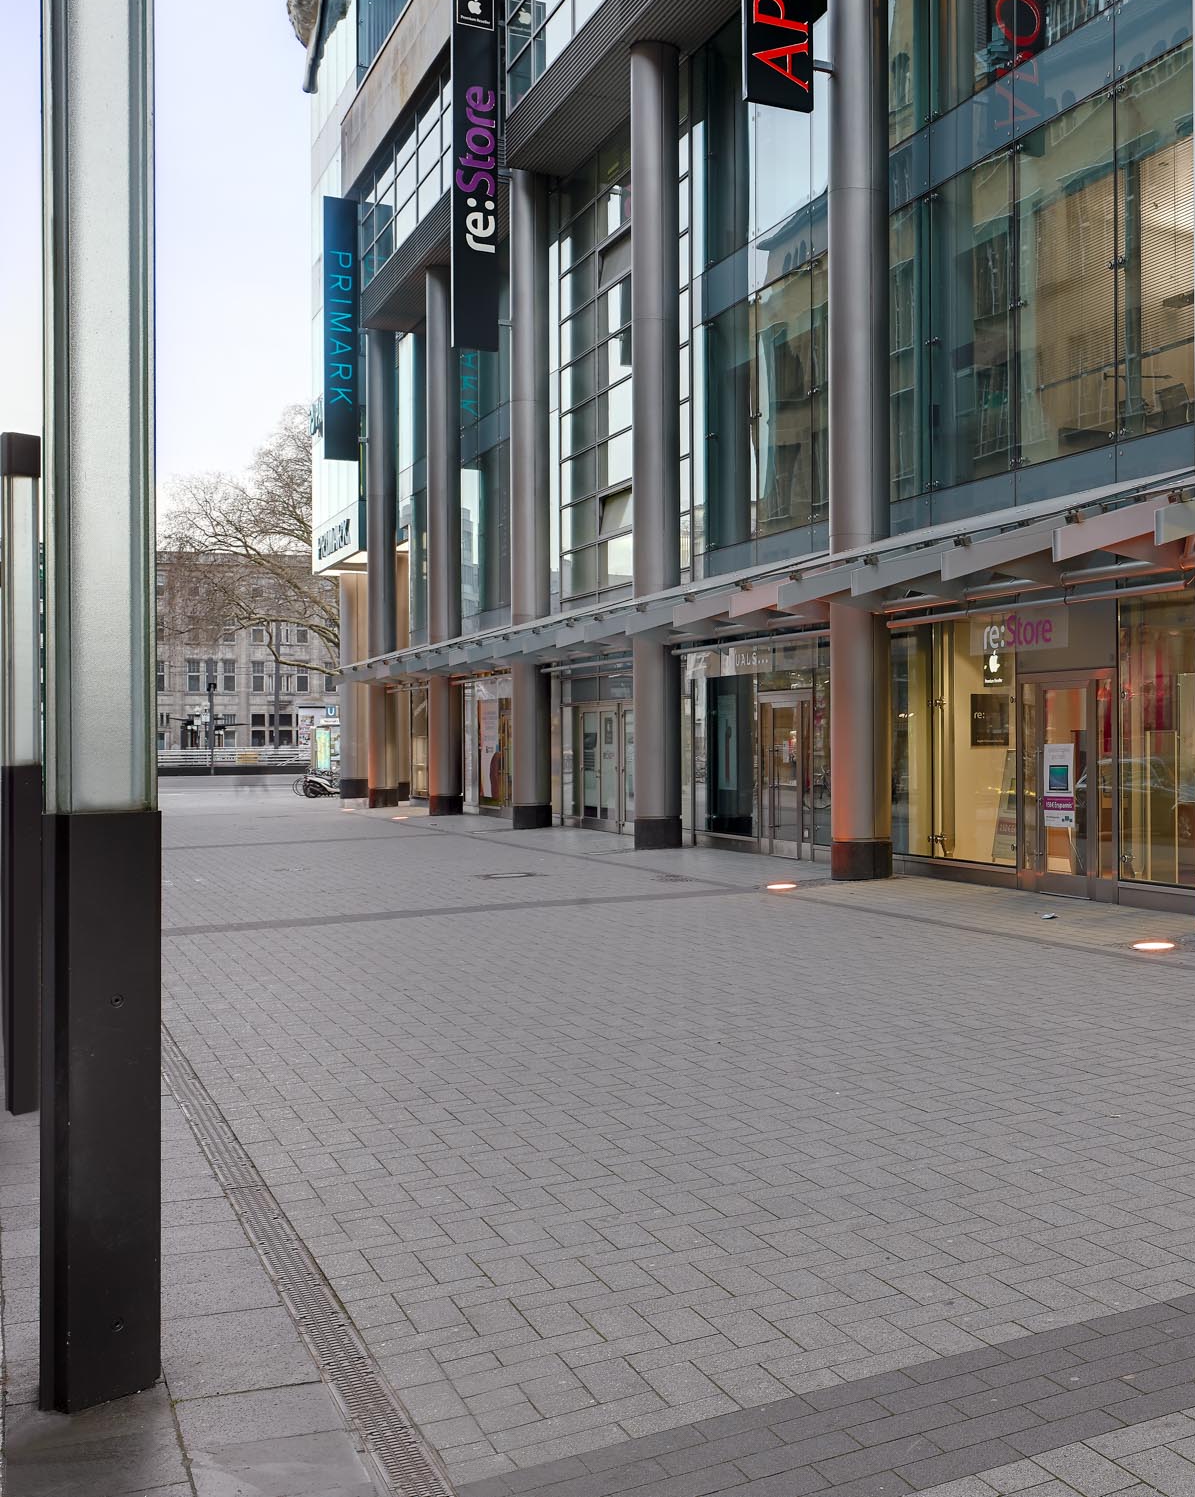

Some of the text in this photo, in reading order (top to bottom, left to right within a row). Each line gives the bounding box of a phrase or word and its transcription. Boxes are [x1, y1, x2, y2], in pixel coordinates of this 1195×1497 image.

[329, 249, 353, 406] PRIMARK
[318, 518, 351, 561] PRIMARK
[983, 614, 1053, 650] re:Store
[327, 707, 335, 716] U
